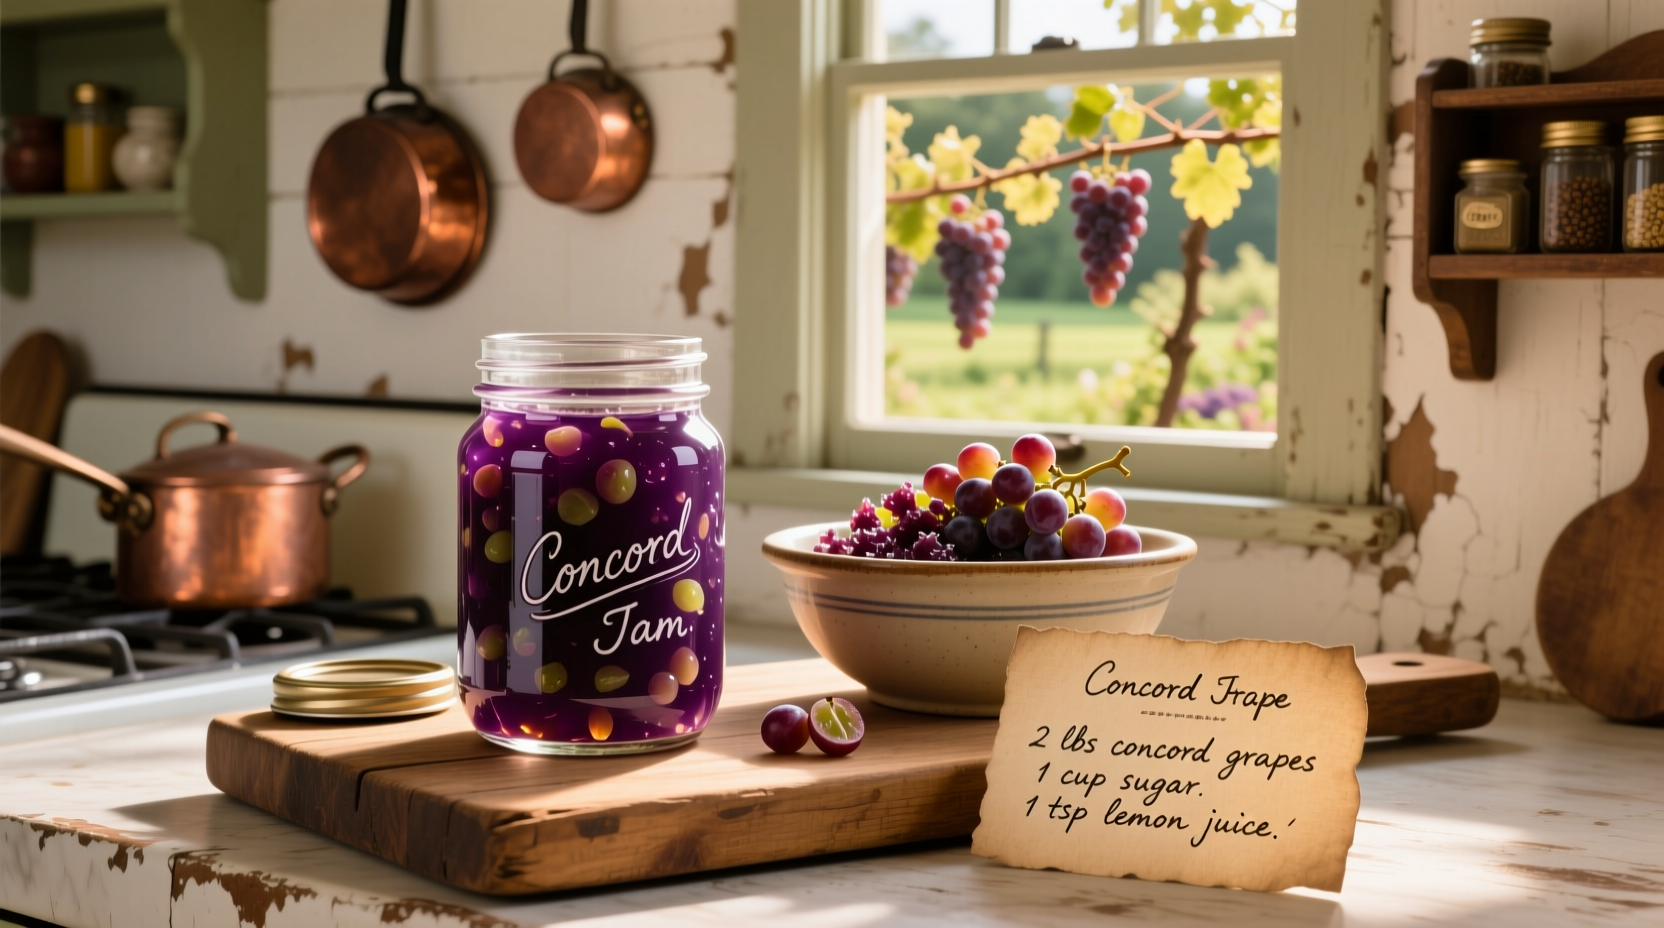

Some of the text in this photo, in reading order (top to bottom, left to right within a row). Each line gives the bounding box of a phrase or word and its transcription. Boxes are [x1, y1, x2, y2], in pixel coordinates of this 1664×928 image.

[521, 497, 693, 605] Concord
[1085, 660, 1203, 701] Concord
[1028, 725, 1317, 781] 2 lbs concord grapes
[1037, 761, 1203, 807] 1 cup sugar.
[1025, 795, 1039, 817] 1
[1048, 795, 1088, 834] tsp
[1103, 797, 1190, 830] lemon
